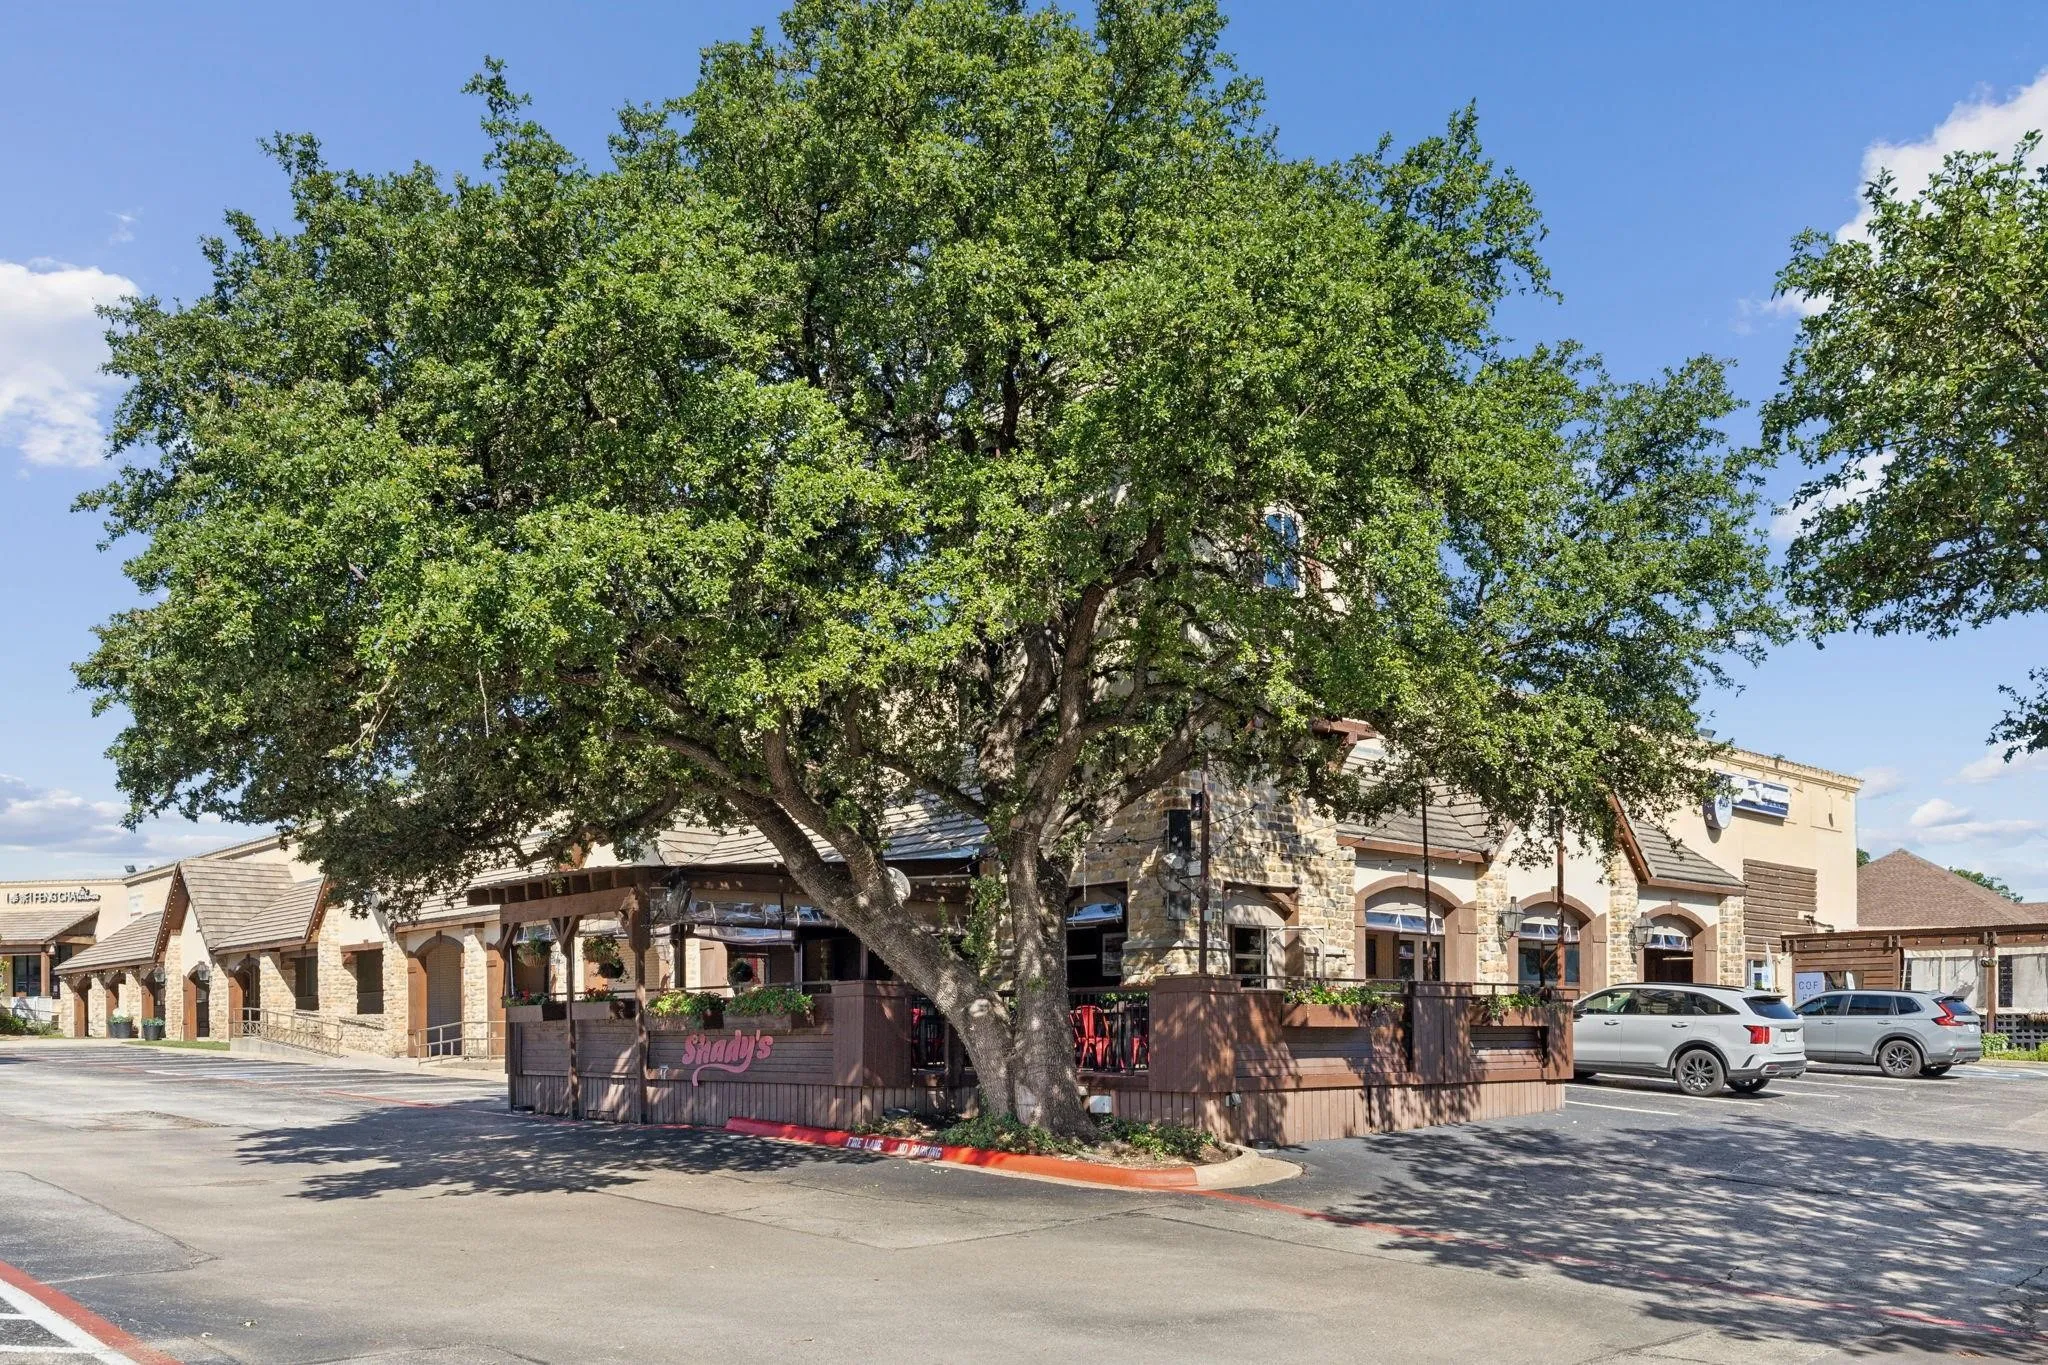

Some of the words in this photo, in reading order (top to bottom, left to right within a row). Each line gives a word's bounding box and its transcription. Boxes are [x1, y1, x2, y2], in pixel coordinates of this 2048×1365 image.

[1798, 980, 1818, 990] COF
[682, 1029, 774, 1087] Shady's
[846, 1136, 864, 1149] FIRE
[864, 1138, 884, 1151] LANE
[897, 1142, 909, 1154] NO
[909, 1143, 943, 1158] PARKING
